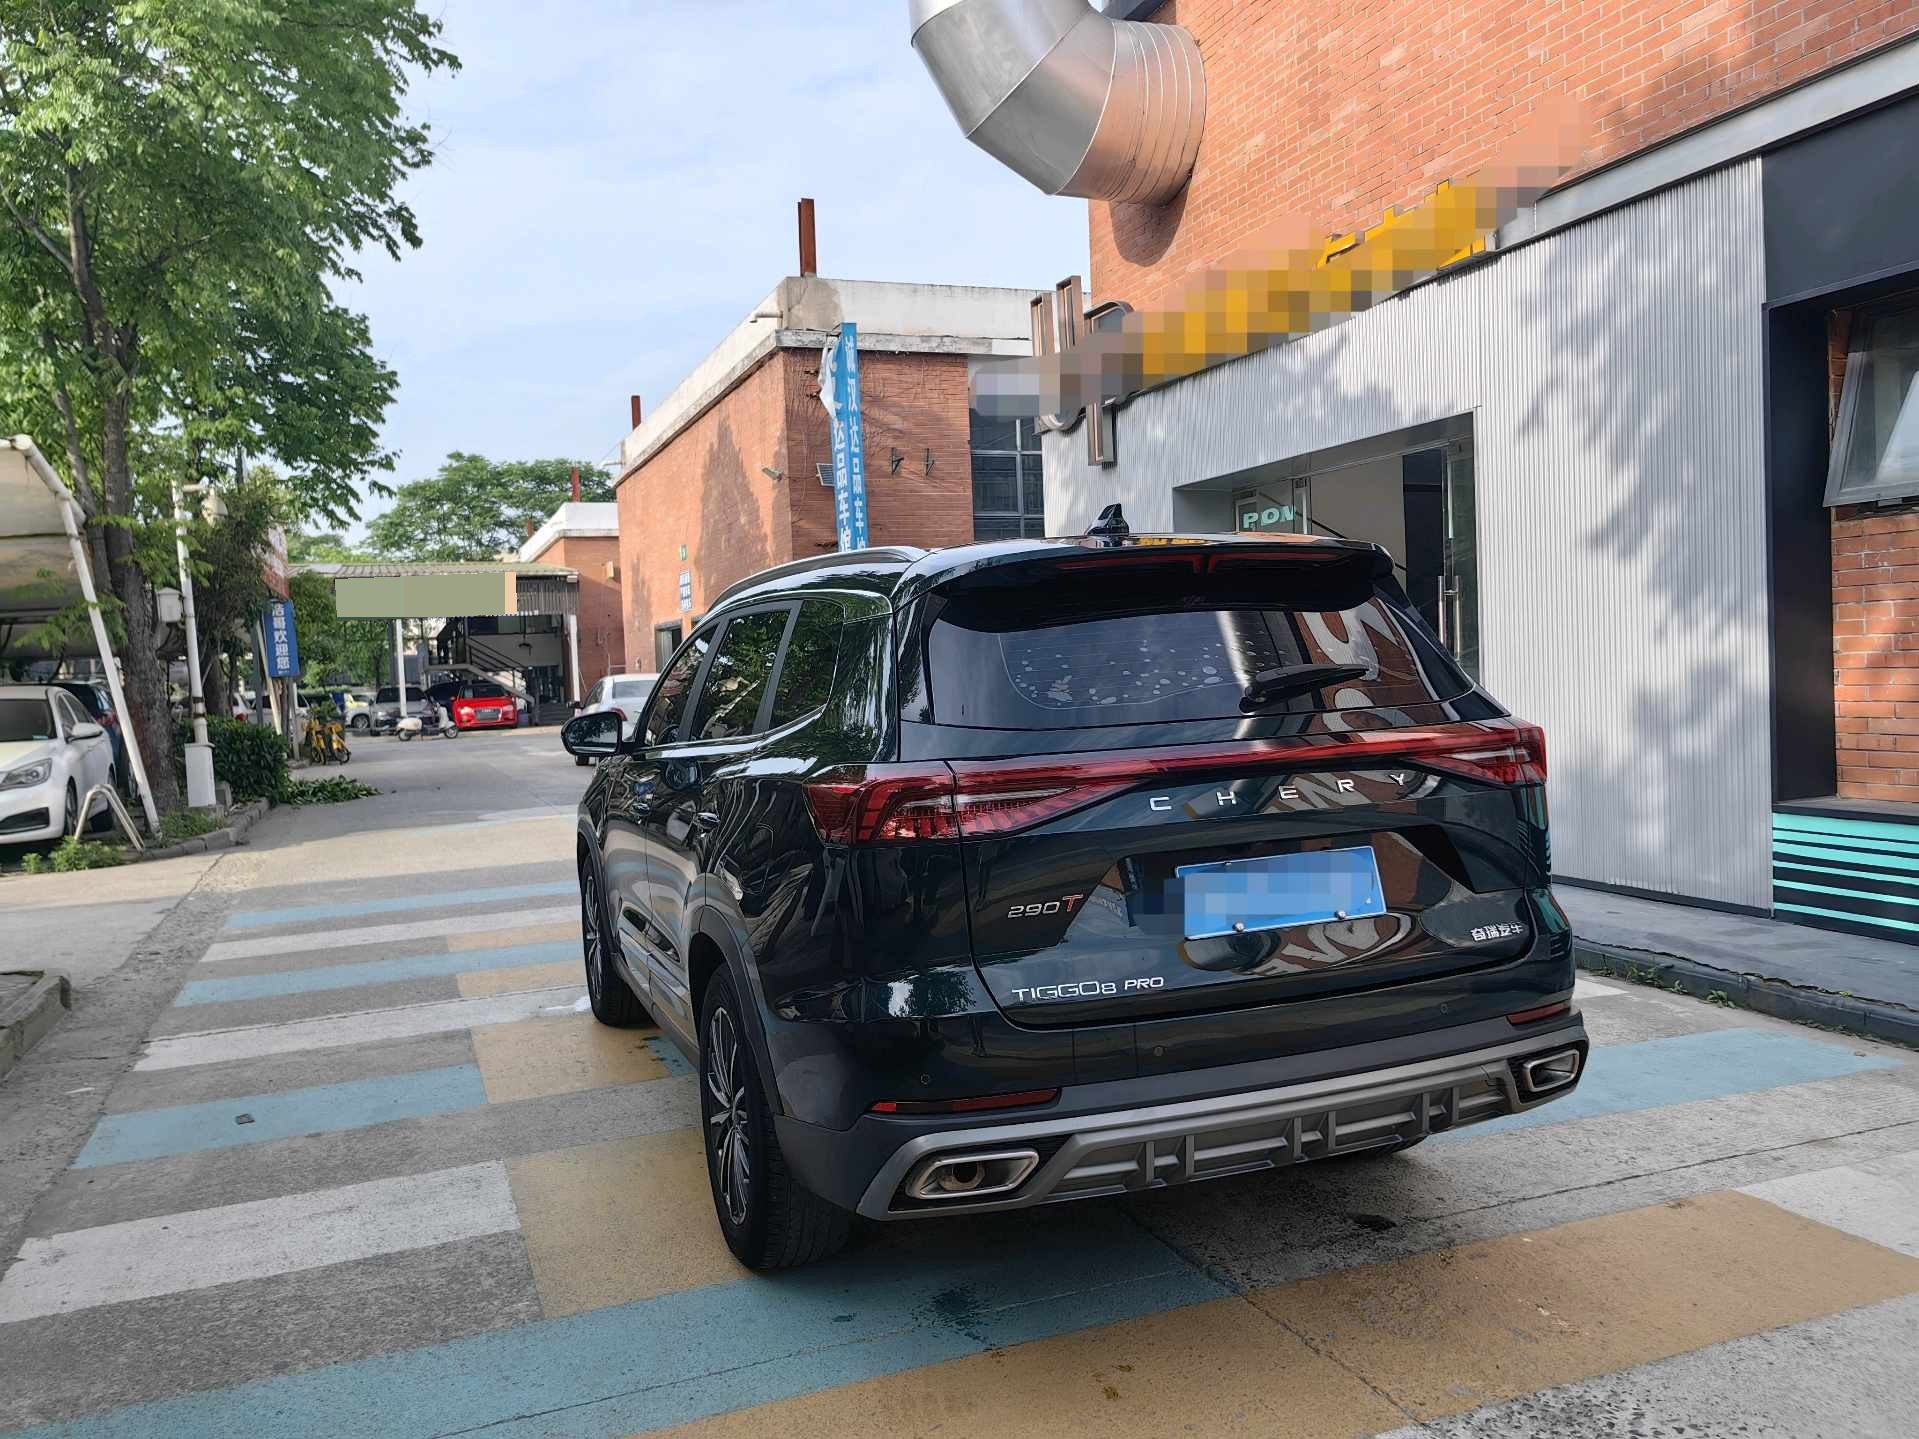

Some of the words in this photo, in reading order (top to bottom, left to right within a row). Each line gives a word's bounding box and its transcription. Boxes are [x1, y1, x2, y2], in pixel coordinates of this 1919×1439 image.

[1149, 772, 1406, 812] CHERY
[1007, 894, 1084, 919] 290T
[1470, 921, 1523, 942] 奇瑞汽车
[1124, 976, 1165, 990] PRO
